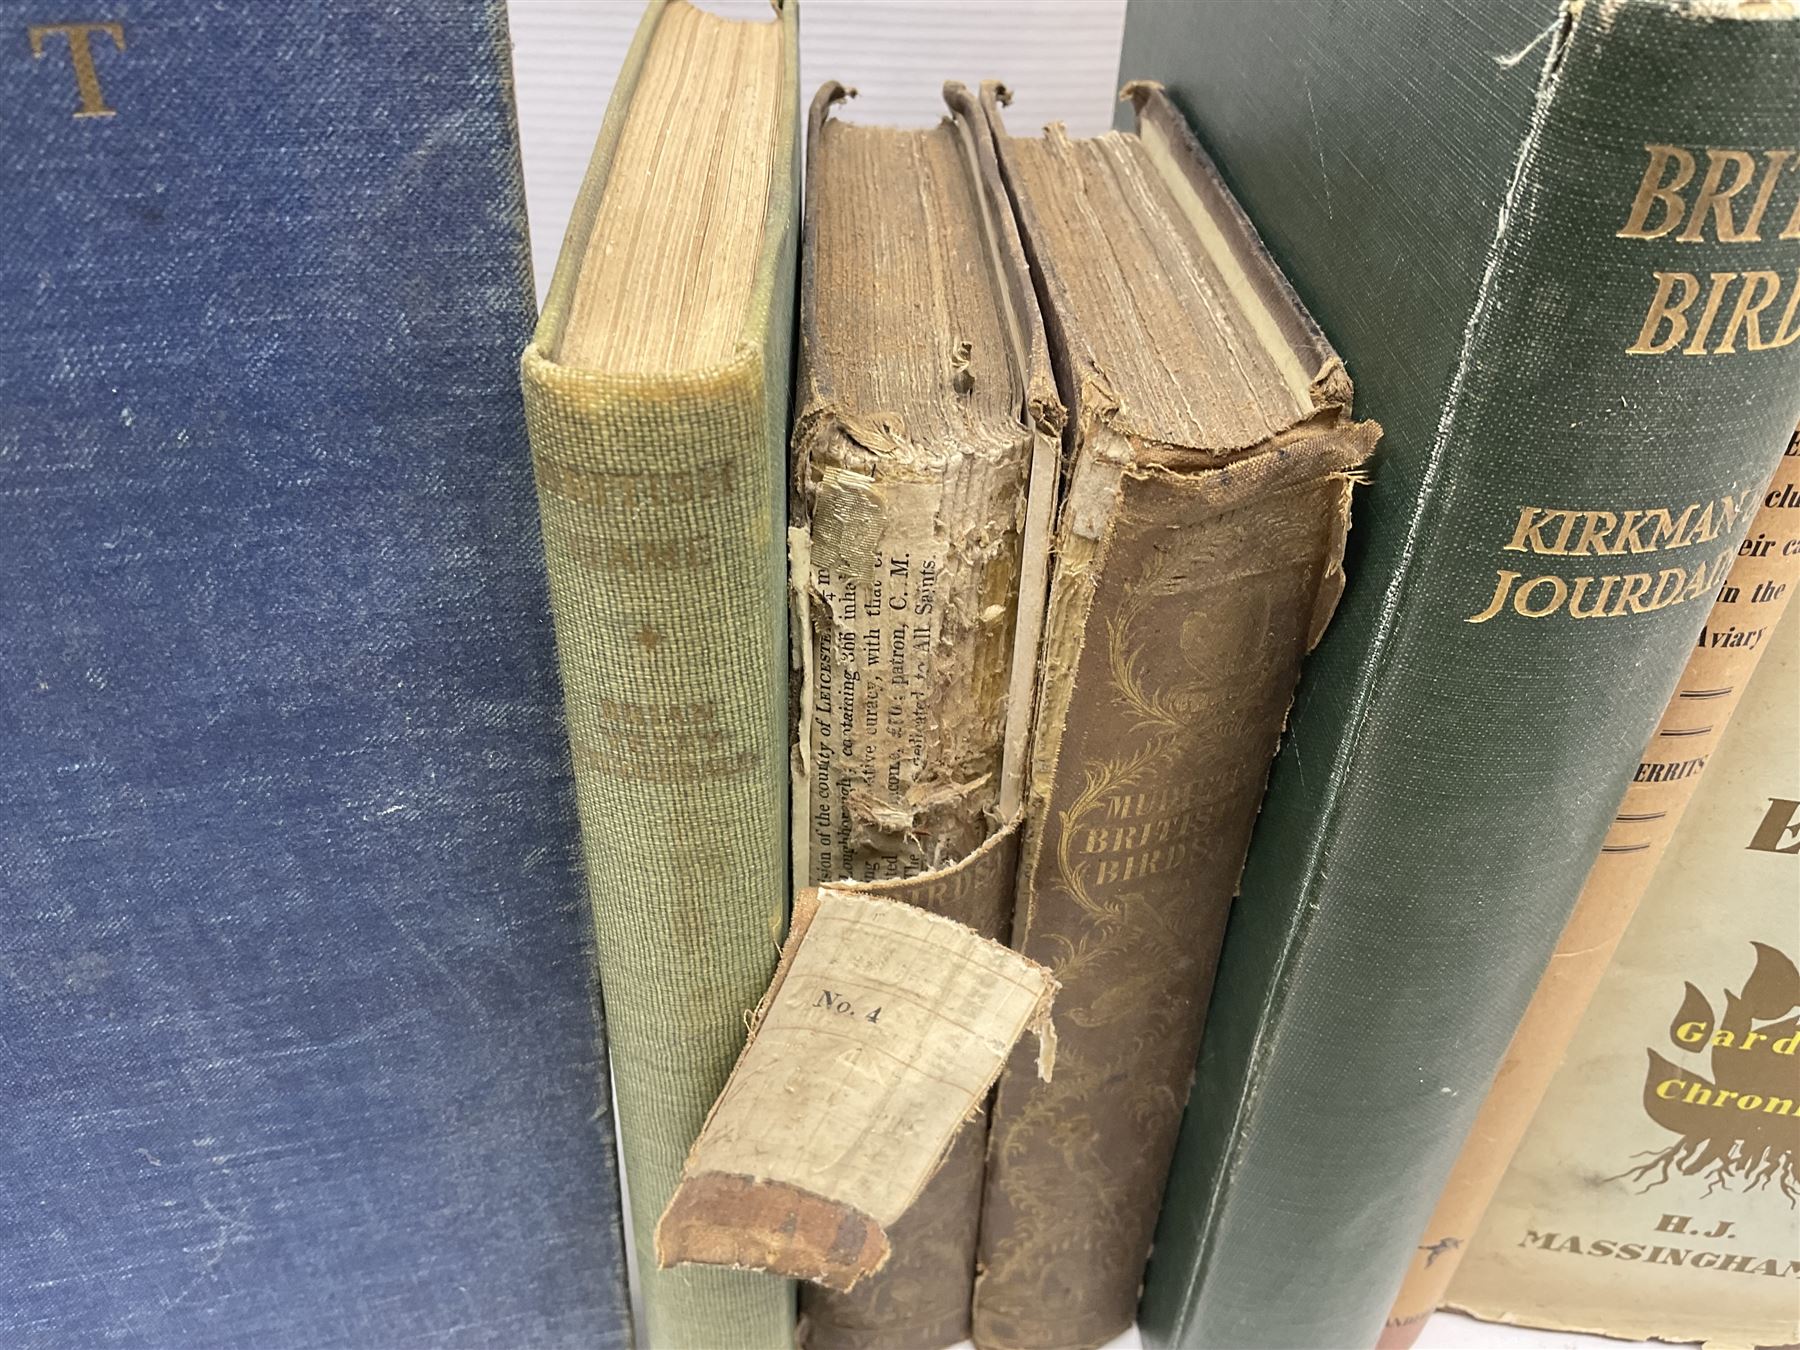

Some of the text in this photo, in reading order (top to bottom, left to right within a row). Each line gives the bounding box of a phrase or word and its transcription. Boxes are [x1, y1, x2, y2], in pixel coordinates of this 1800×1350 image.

[28, 23, 127, 118] T
[1503, 490, 1751, 556] KIRKMAN
[890, 553, 910, 579] M.
[1751, 580, 1786, 603] the
[863, 629, 880, 665] with
[890, 624, 909, 685] patron,
[914, 627, 931, 653] All
[815, 717, 831, 737] of
[817, 741, 835, 799] county
[815, 805, 830, 827] the
[815, 829, 831, 846] of
[812, 989, 882, 1023] No. 4
